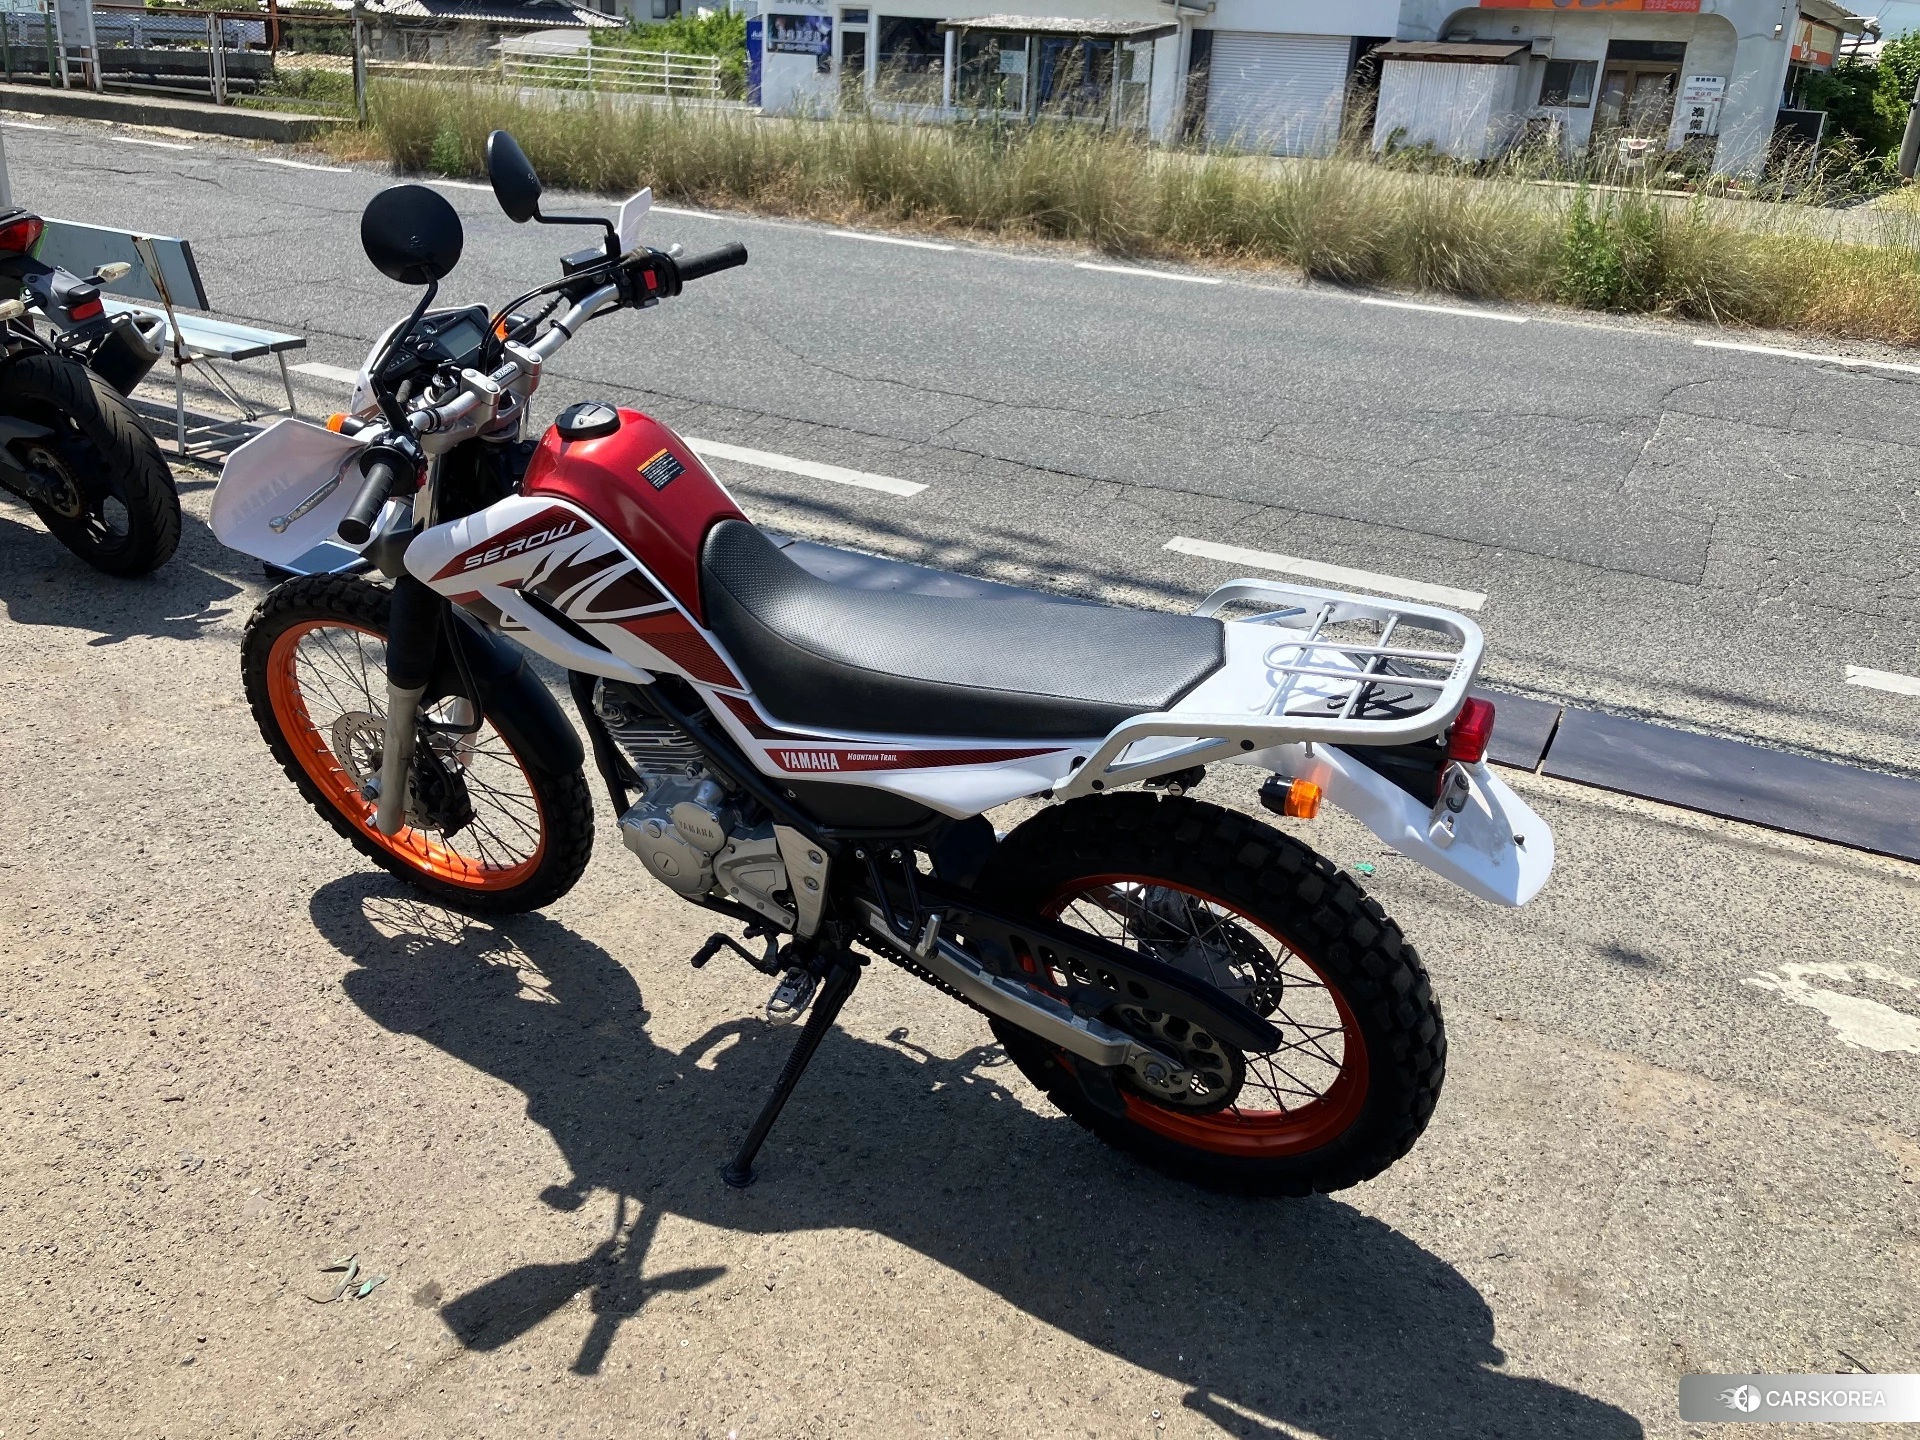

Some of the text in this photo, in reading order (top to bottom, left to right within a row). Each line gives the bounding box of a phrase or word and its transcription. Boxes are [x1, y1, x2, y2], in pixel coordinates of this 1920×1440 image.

[1689, 106, 1705, 134] 準備
[463, 520, 577, 570] SEROW
[780, 751, 840, 770] YAMAHA
[678, 819, 714, 839] YAMAHA
